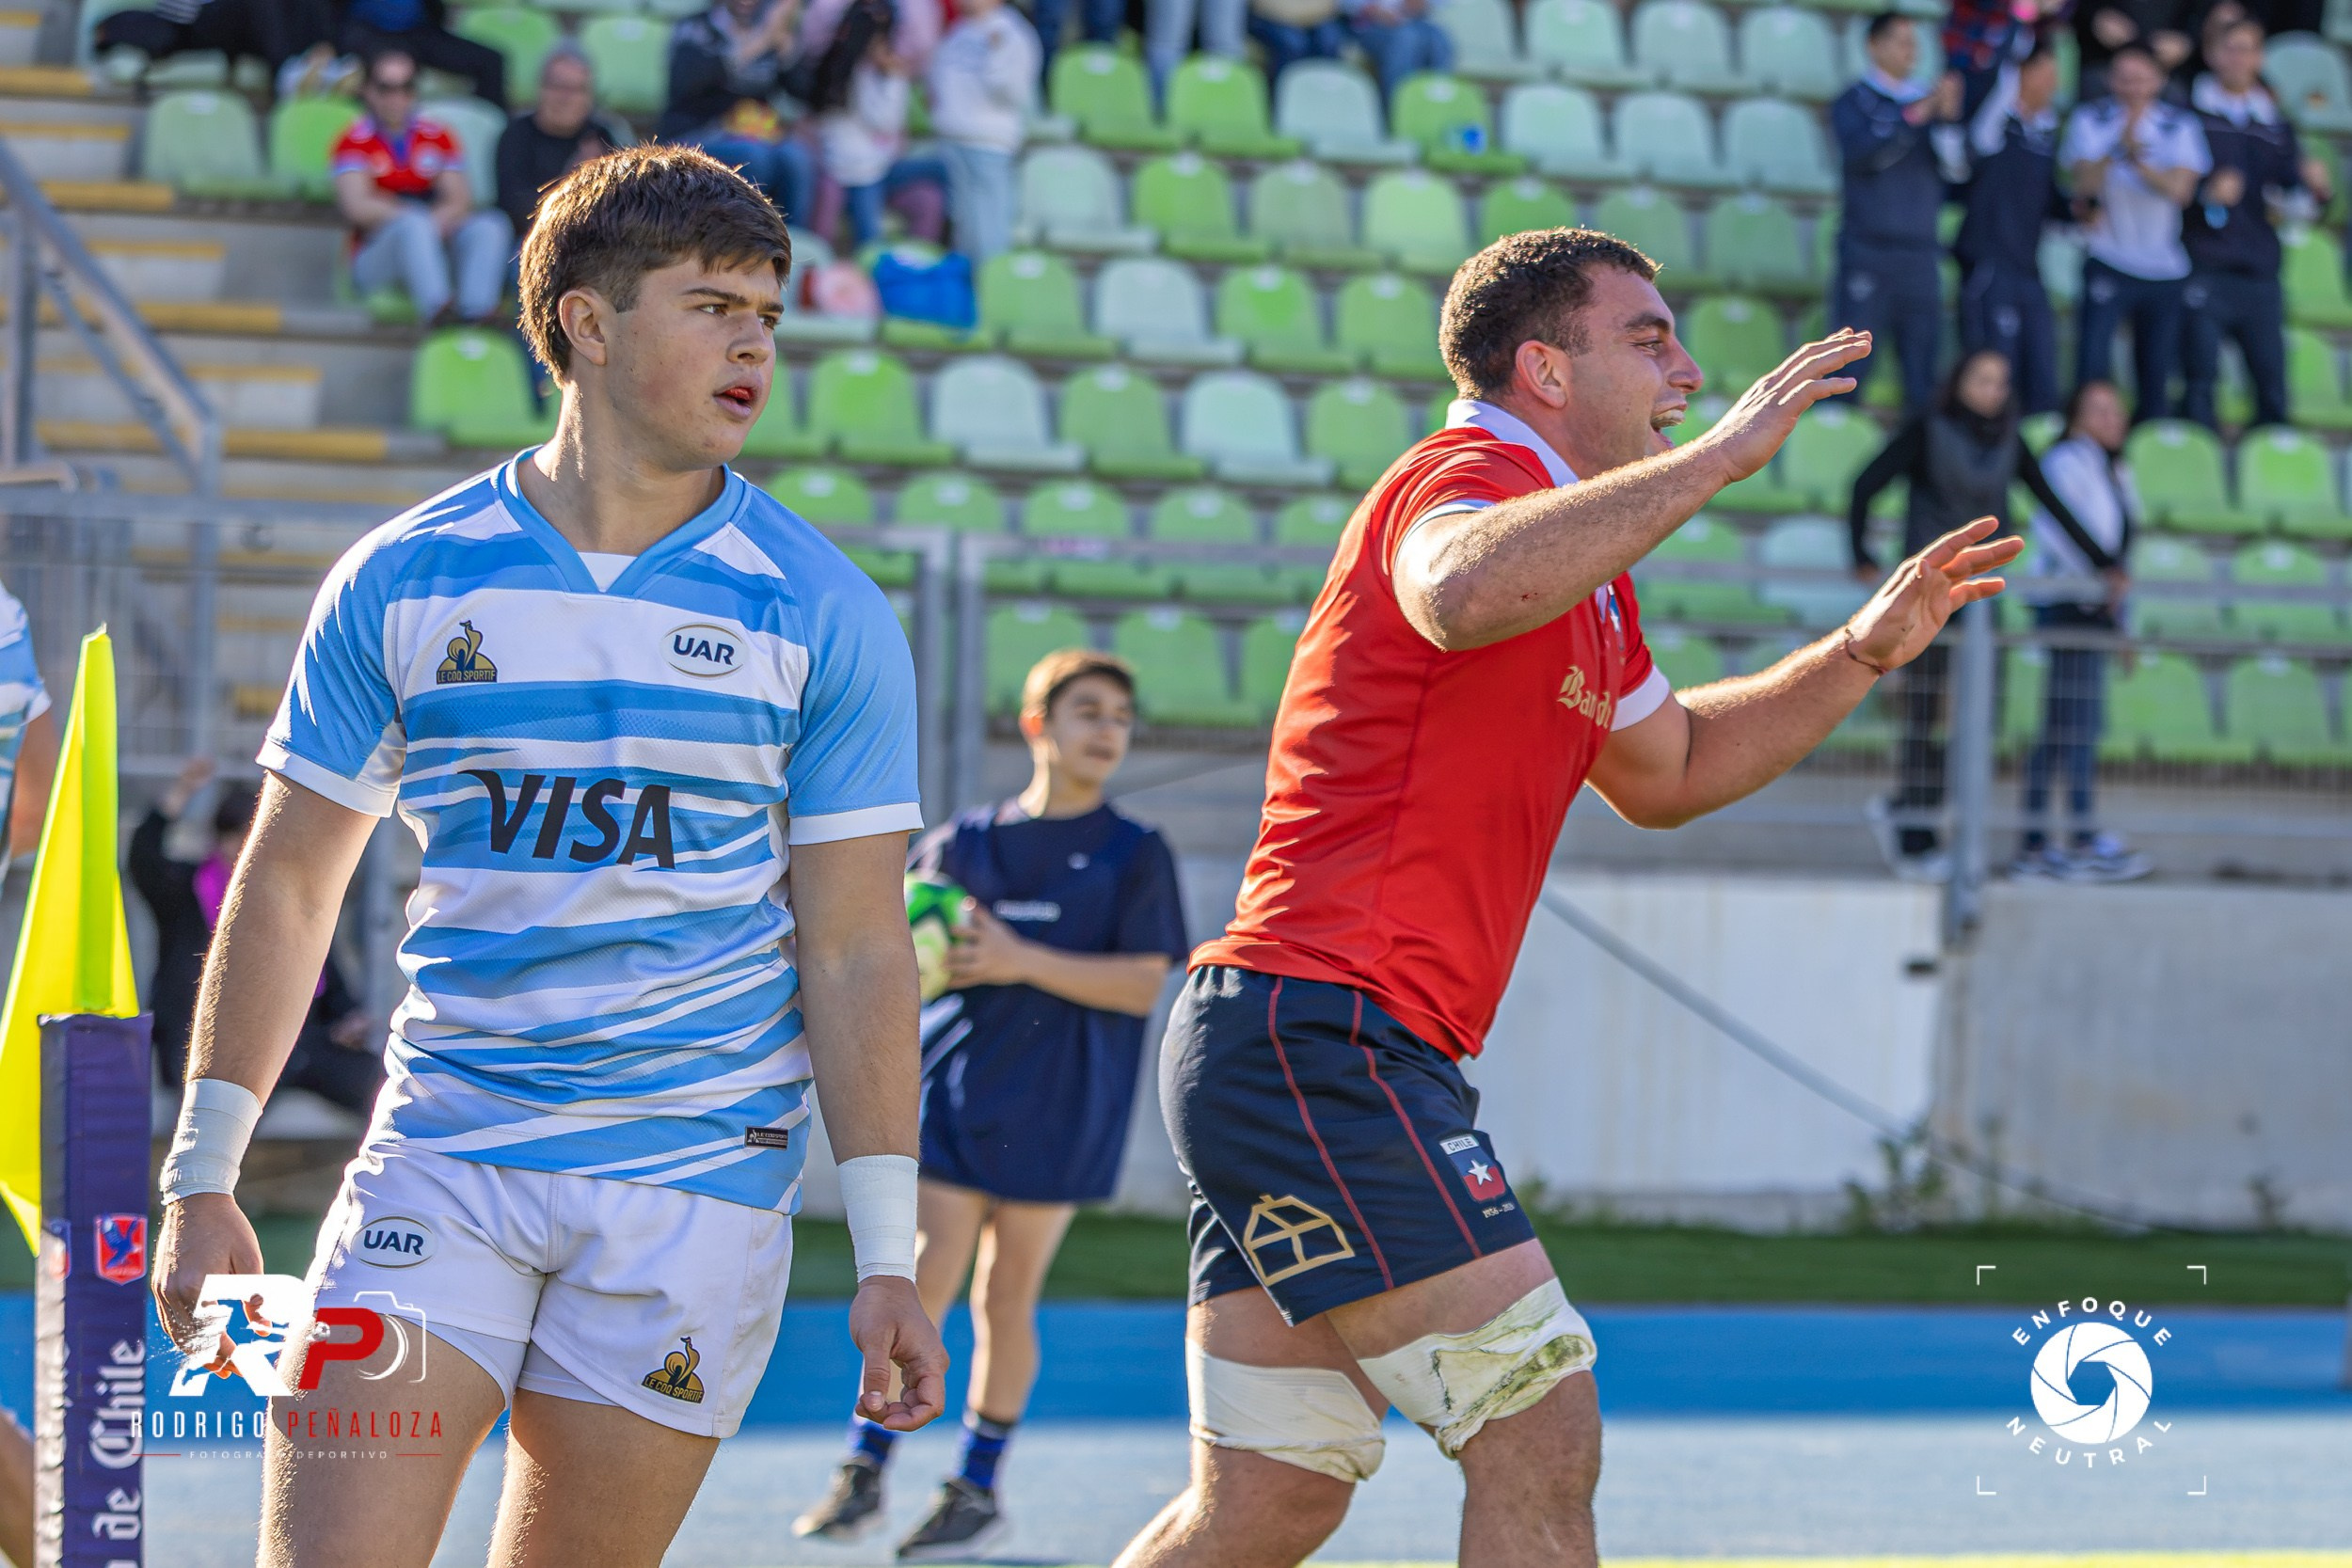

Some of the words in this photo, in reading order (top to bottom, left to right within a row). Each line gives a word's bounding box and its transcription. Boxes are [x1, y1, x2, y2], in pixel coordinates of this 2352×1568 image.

[674, 635, 735, 666] UAR
[437, 671, 446, 683] LE
[447, 671, 462, 682] COQ
[463, 670, 496, 681] SPORTIF
[457, 769, 675, 869] VISA
[1447, 1138, 1473, 1151] CHILE
[363, 1229, 424, 1257] UAR
[644, 1376, 656, 1387] LE
[656, 1381, 672, 1395] COQ
[673, 1386, 703, 1402] SPORTIF
[88, 1339, 146, 1469] Chile
[91, 1487, 141, 1540] de
